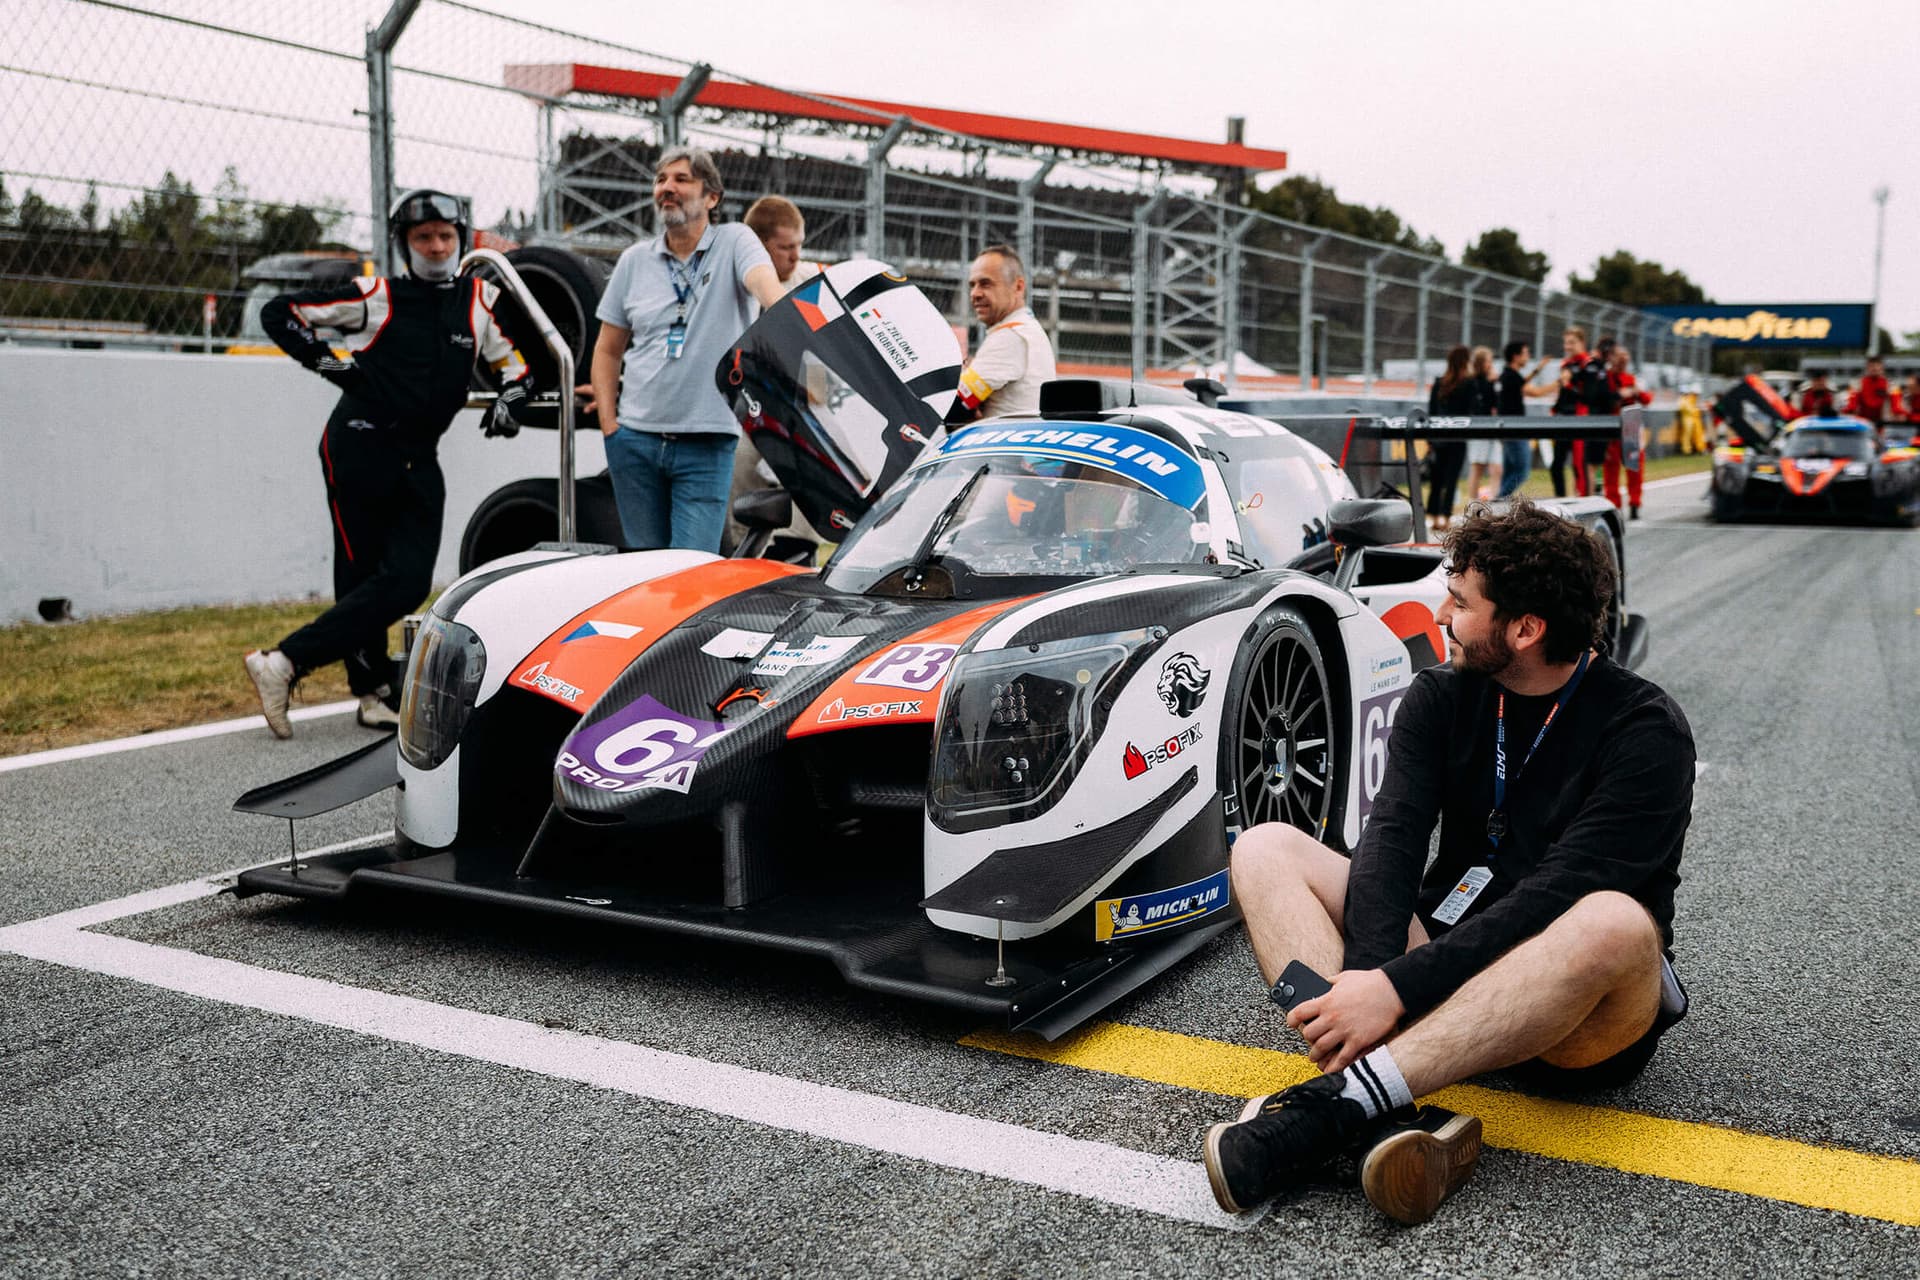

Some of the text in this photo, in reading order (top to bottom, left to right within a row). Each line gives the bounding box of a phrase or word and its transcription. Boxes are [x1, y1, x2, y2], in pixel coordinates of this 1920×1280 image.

[1672, 310, 1832, 341] GOODYEAR
[950, 429, 1181, 477] MICHELIN
[865, 646, 956, 684] P3
[531, 673, 584, 702] PSOFIX
[841, 701, 923, 720] PSOFIX
[1143, 722, 1204, 771] PSOFIX
[554, 752, 625, 790] PRO
[1144, 886, 1220, 921] MICHLIN
